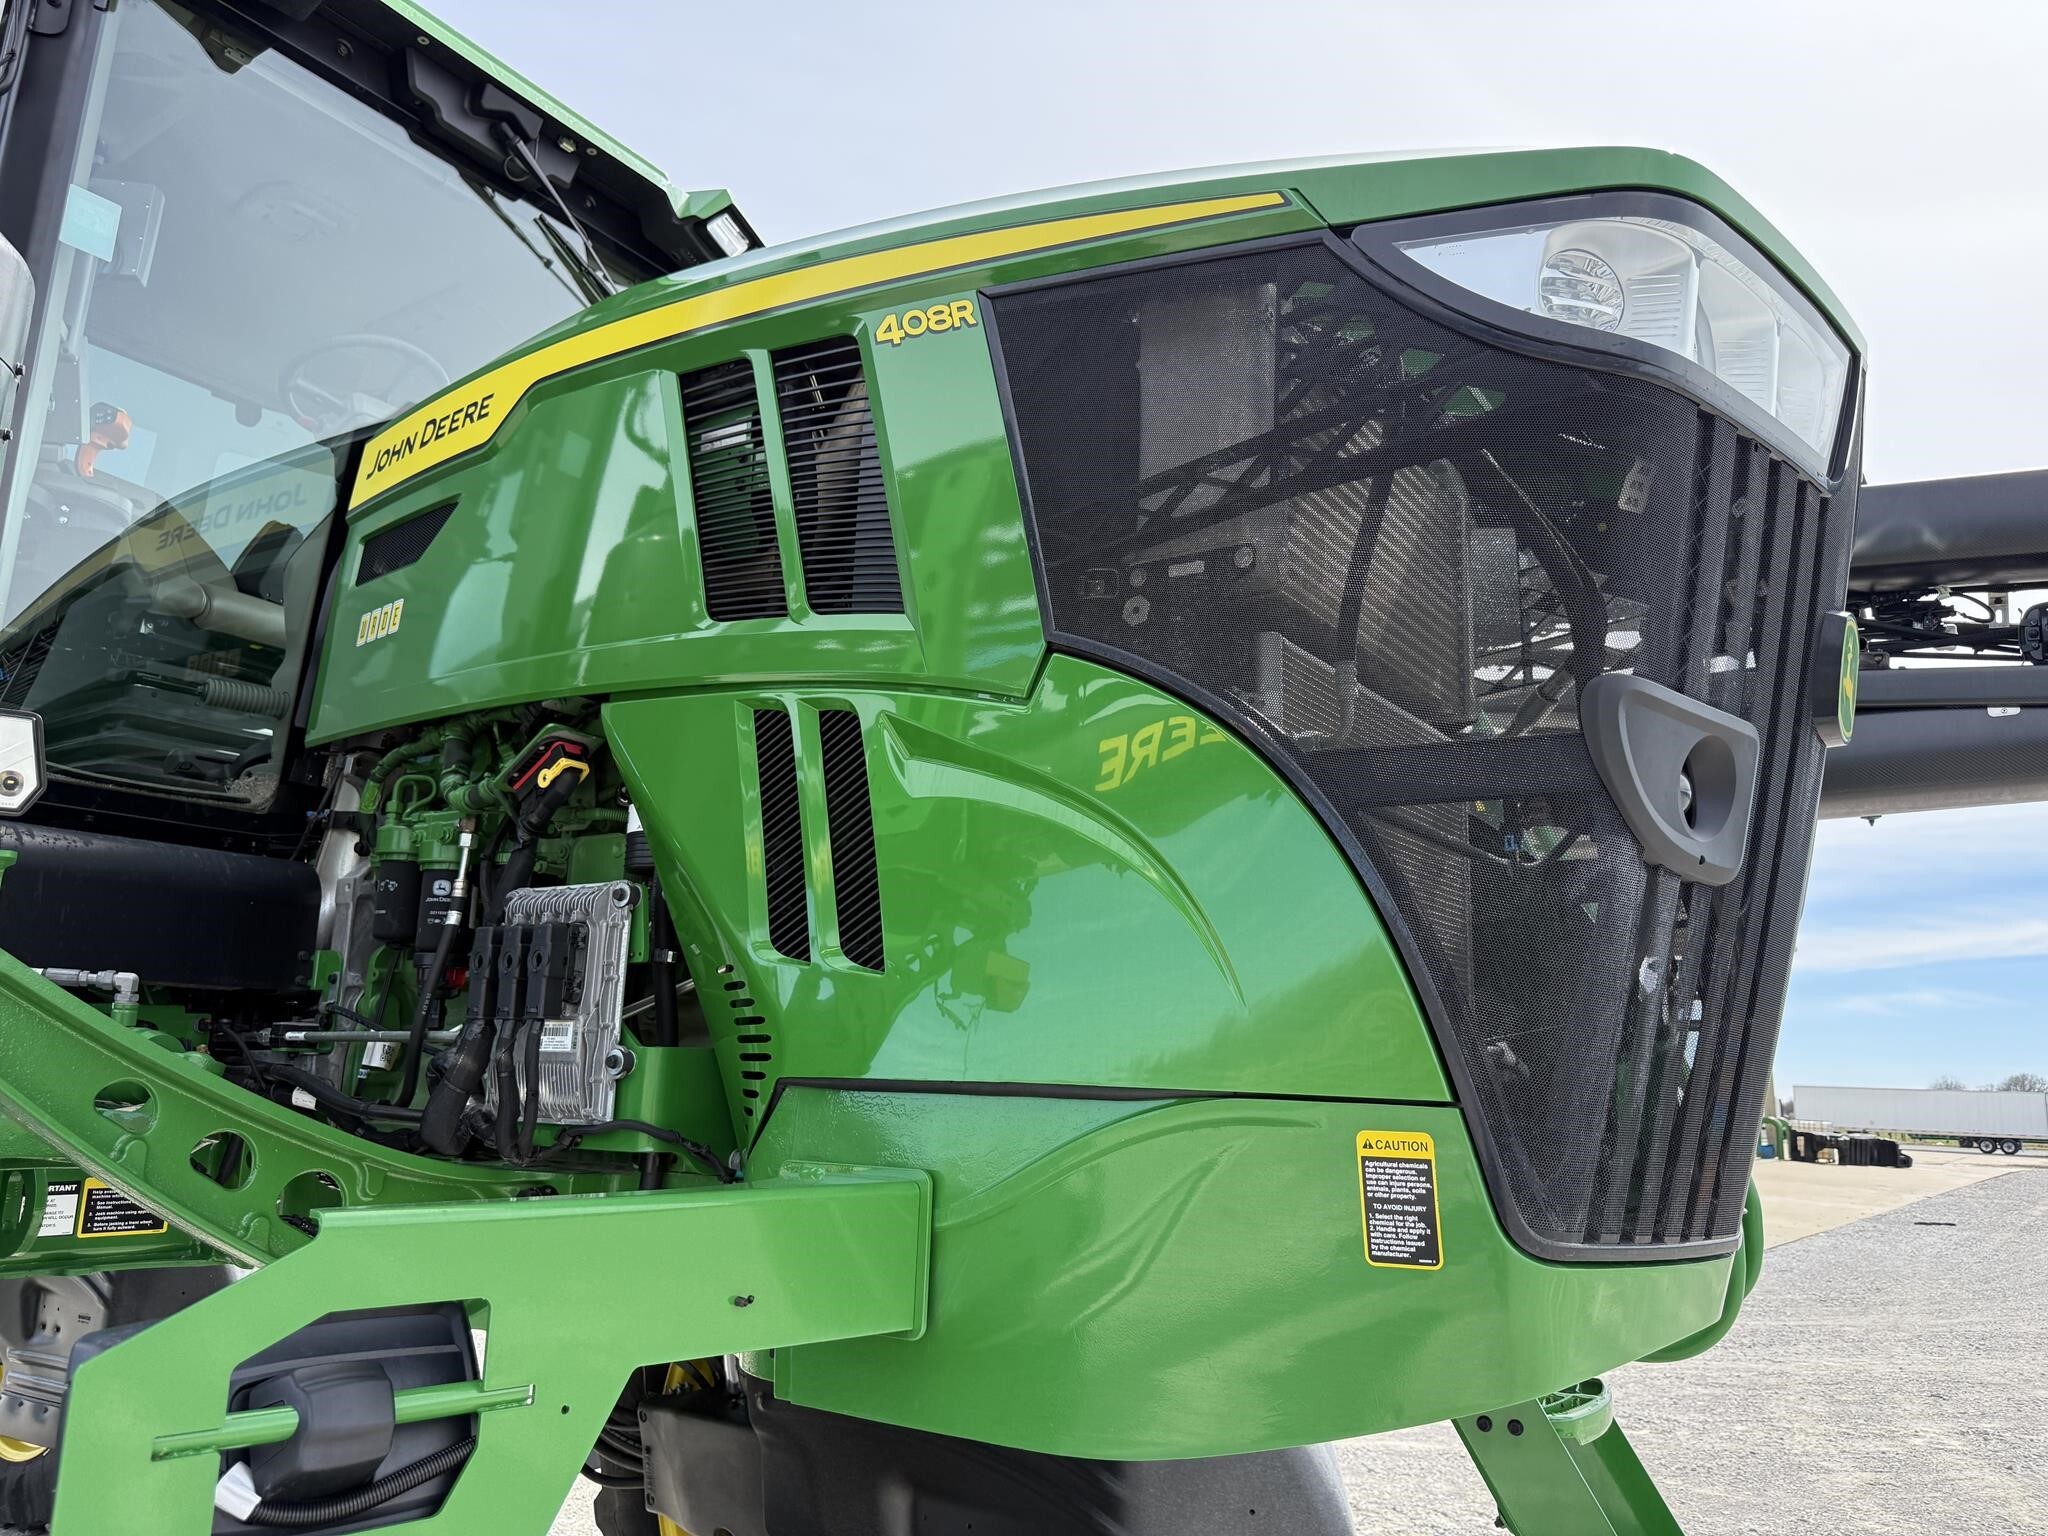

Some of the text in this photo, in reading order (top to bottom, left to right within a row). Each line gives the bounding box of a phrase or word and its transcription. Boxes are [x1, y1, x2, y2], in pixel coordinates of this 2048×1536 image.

[875, 299, 977, 347] 408R
[366, 392, 495, 480] JOHN DEERE
[1375, 1139, 1428, 1152] CAUTION
[1365, 1160, 1398, 1168] Agricultural
[48, 1184, 77, 1192] RTANT
[1371, 1250, 1411, 1258] manufacturer.
